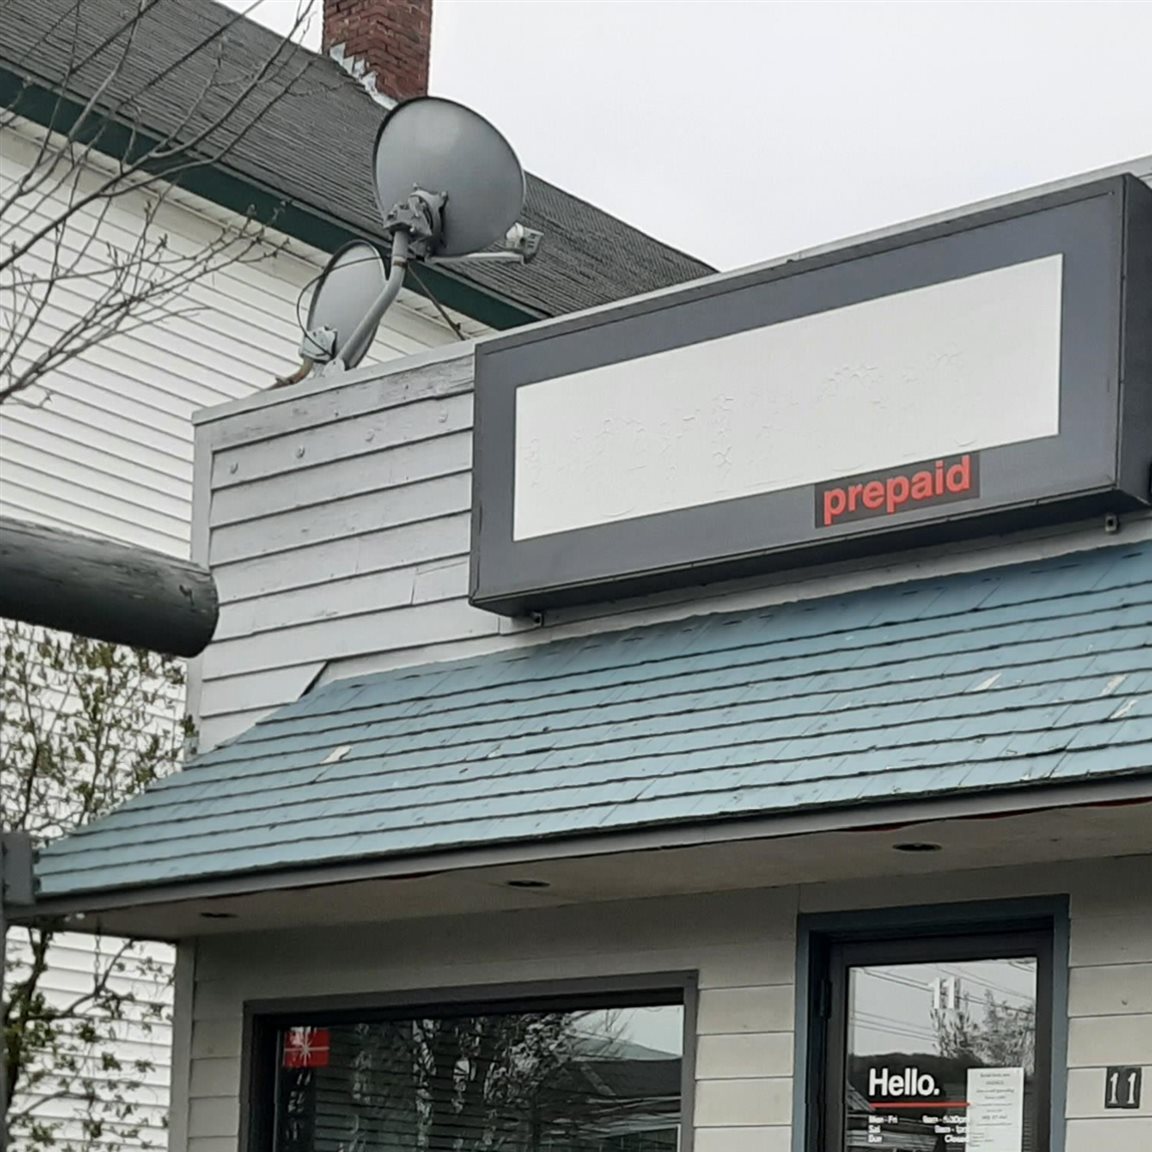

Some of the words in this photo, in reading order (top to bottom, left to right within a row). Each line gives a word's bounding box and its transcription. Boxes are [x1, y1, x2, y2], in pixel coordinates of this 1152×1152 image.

[823, 454, 971, 527] prepaid
[928, 976, 955, 1009] 11
[868, 1067, 940, 1096] Hello.
[1109, 1072, 1137, 1104] 11
